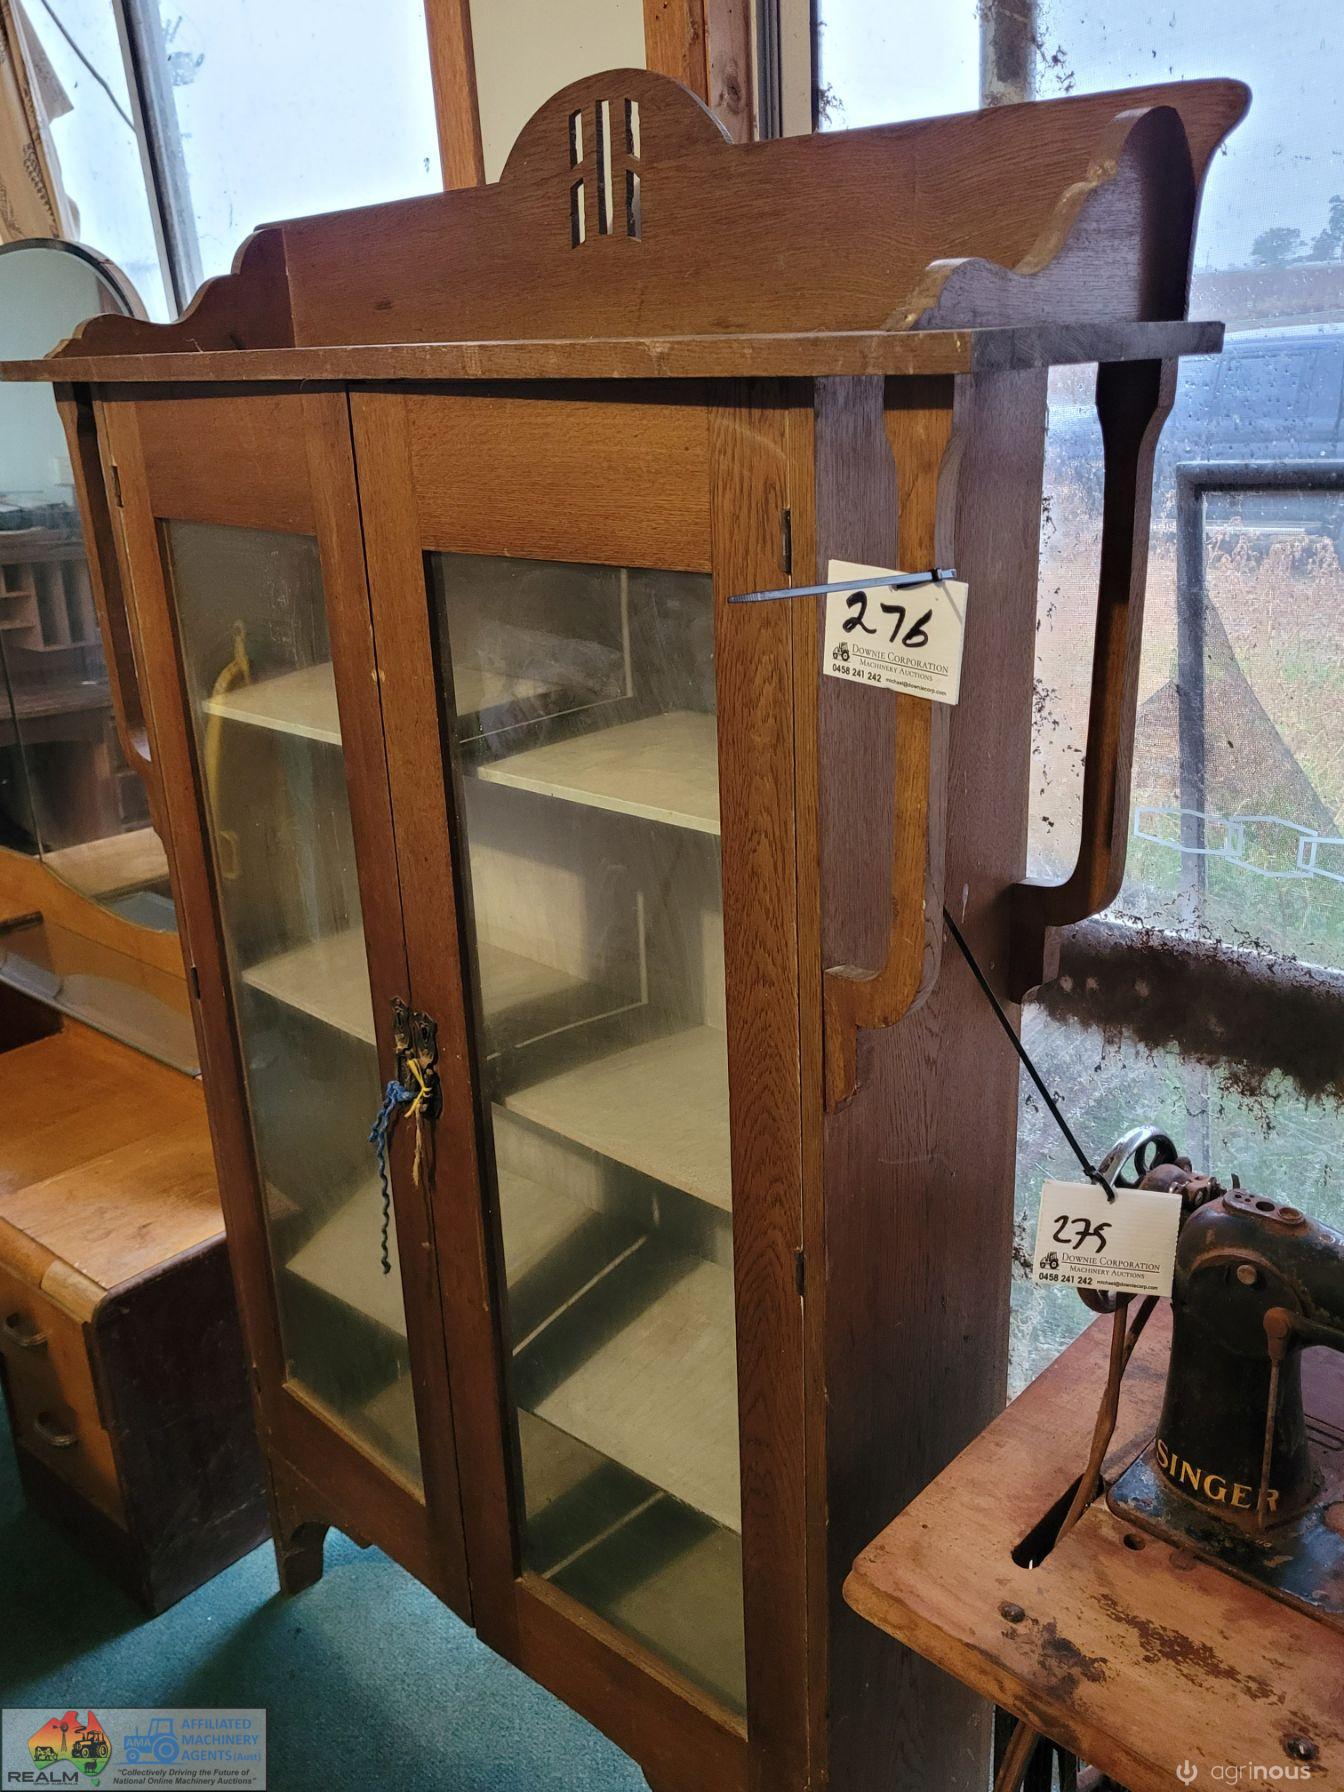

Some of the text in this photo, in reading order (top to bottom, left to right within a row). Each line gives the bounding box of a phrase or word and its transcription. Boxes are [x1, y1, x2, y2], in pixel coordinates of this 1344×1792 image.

[842, 591, 933, 648] 276
[852, 643, 949, 673] DOWNIE CORPORATION
[832, 663, 882, 683] 0458 241 242
[860, 659, 933, 681] MACHINERY AUCTIONS
[1052, 1215, 1112, 1253] 275
[1061, 1252, 1161, 1271] DOWNIE CORPORATION
[1069, 1265, 1145, 1279] MACHINERY AUCTIONS
[1038, 1272, 1093, 1286] 0458 241 242
[1156, 1439, 1280, 1513] SINGER
